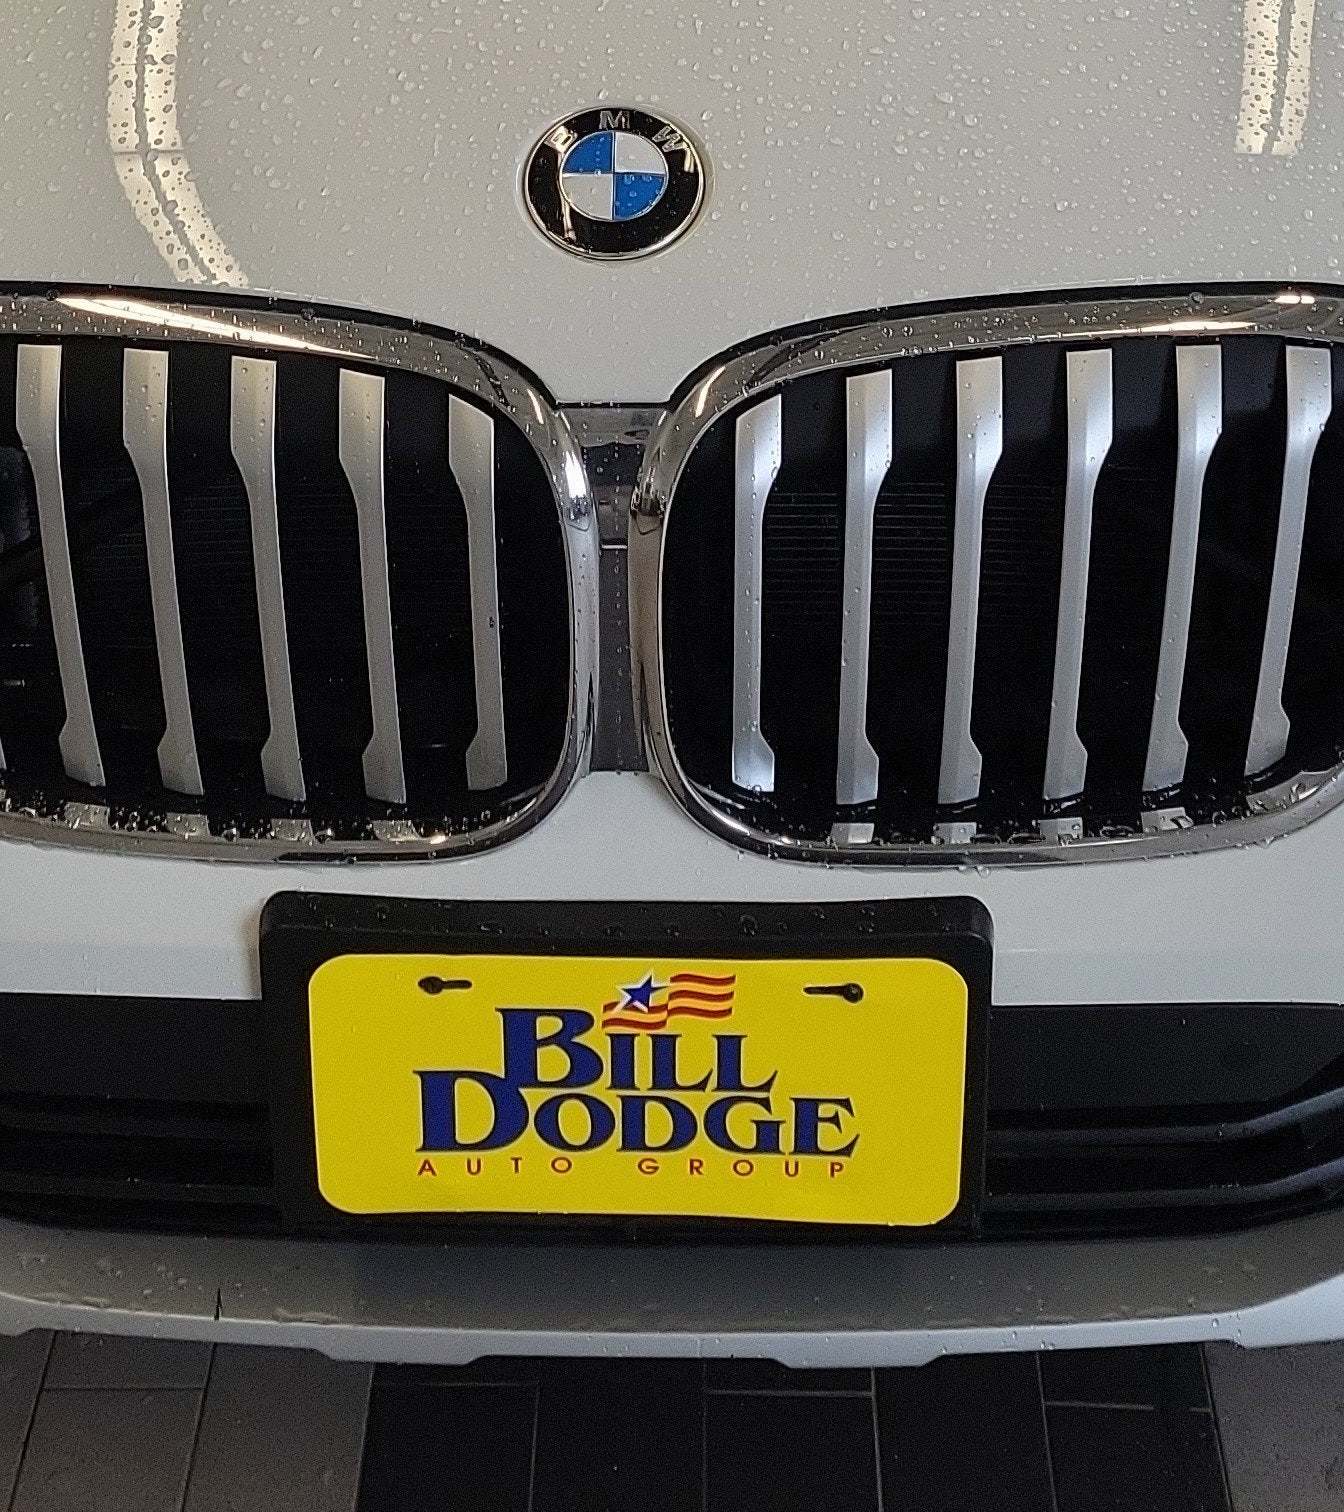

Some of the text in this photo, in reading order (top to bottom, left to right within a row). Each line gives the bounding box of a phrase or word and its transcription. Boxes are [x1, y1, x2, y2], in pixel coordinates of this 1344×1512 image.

[544, 110, 689, 154] BMW
[494, 1007, 779, 1093] BILL
[412, 1070, 861, 1158] DODGE
[417, 1156, 845, 1179] AUTO GROUP
